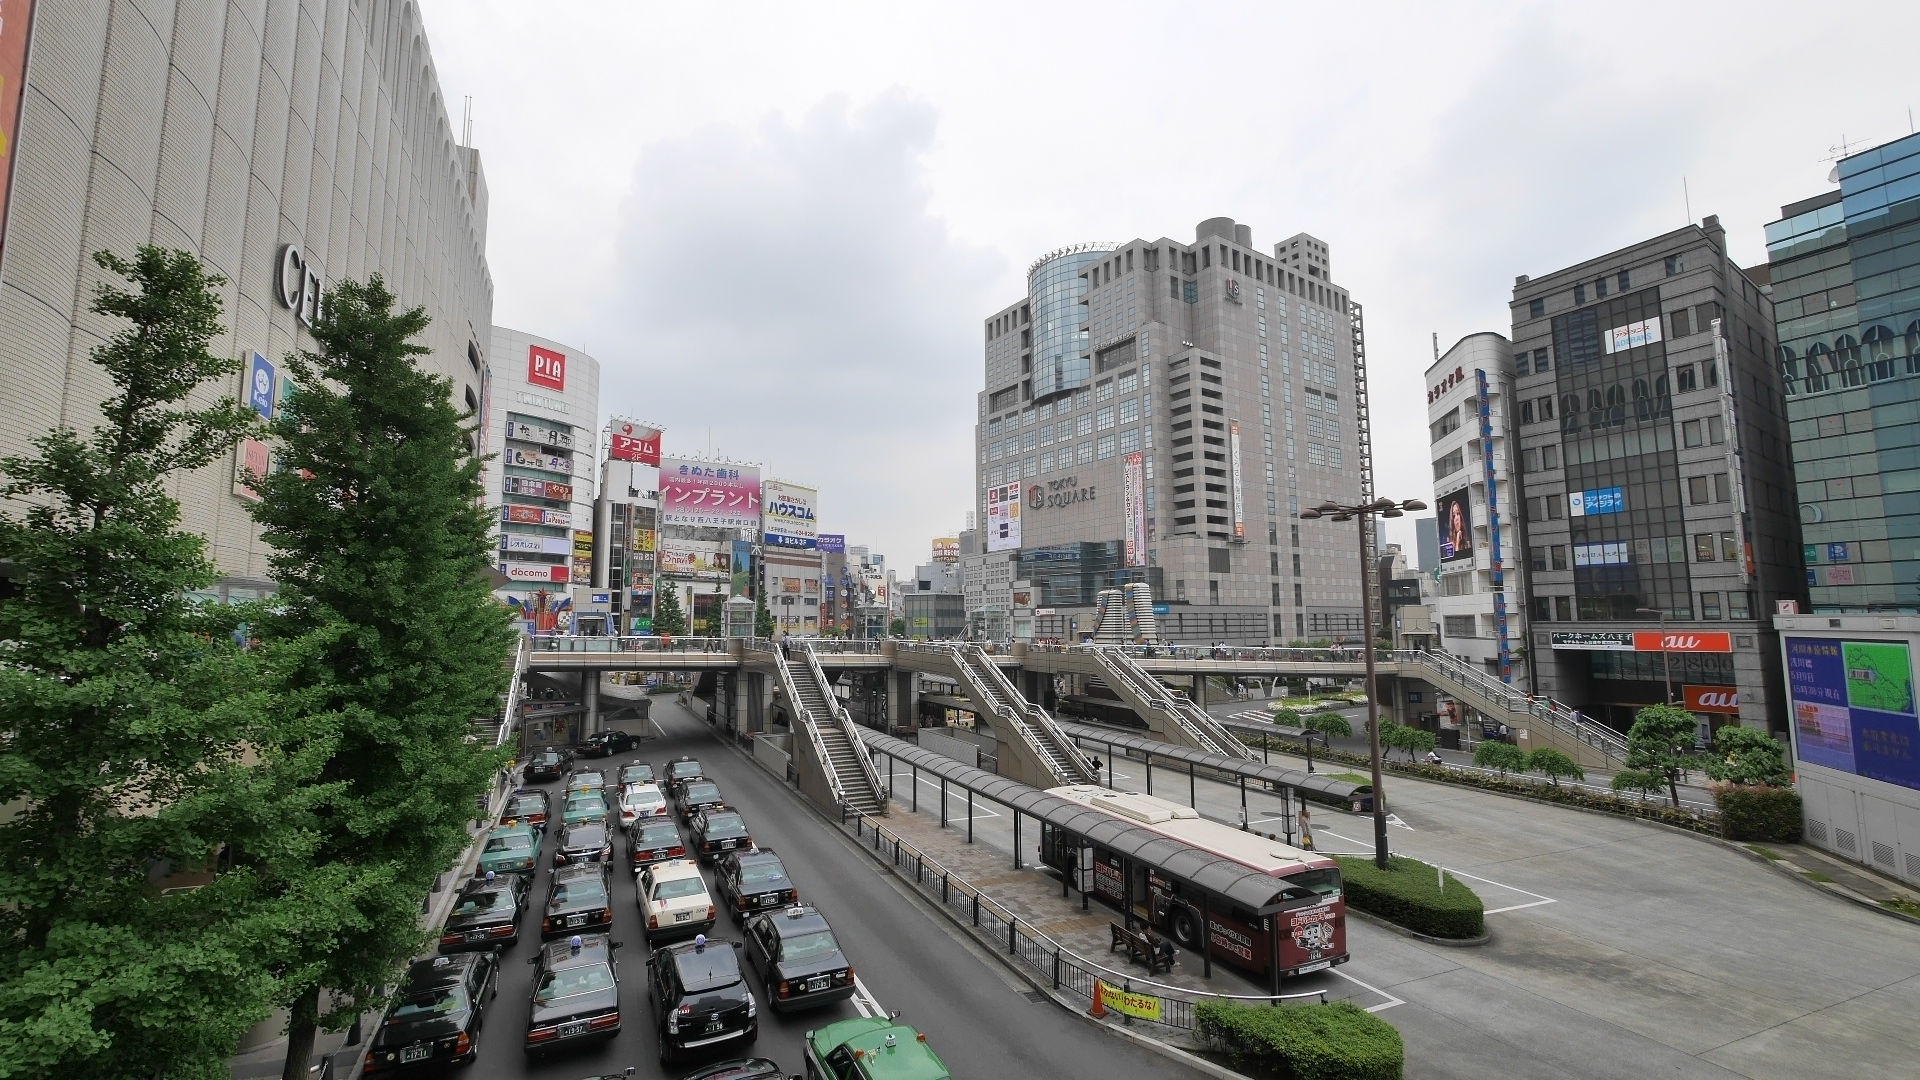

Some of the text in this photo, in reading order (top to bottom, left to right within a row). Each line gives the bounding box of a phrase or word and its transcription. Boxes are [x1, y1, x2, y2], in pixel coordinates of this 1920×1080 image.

[534, 354, 561, 378] PIA
[253, 389, 268, 408] Keio
[620, 437, 654, 454] アコム
[631, 453, 642, 461] 2F
[679, 464, 740, 480] きぬた歯科
[1047, 475, 1078, 492] TOKYU
[660, 485, 760, 509] インプラント
[1047, 485, 1096, 509] SQUARE
[768, 501, 815, 520] ハウスコム
[510, 541, 541, 550] レオパレス21
[511, 567, 548, 577] docomo
[1552, 632, 1633, 641] パークホームズ八王子
[1661, 635, 1701, 648] au
[1790, 670, 1815, 683] 5月9日
[1698, 692, 1739, 707] au
